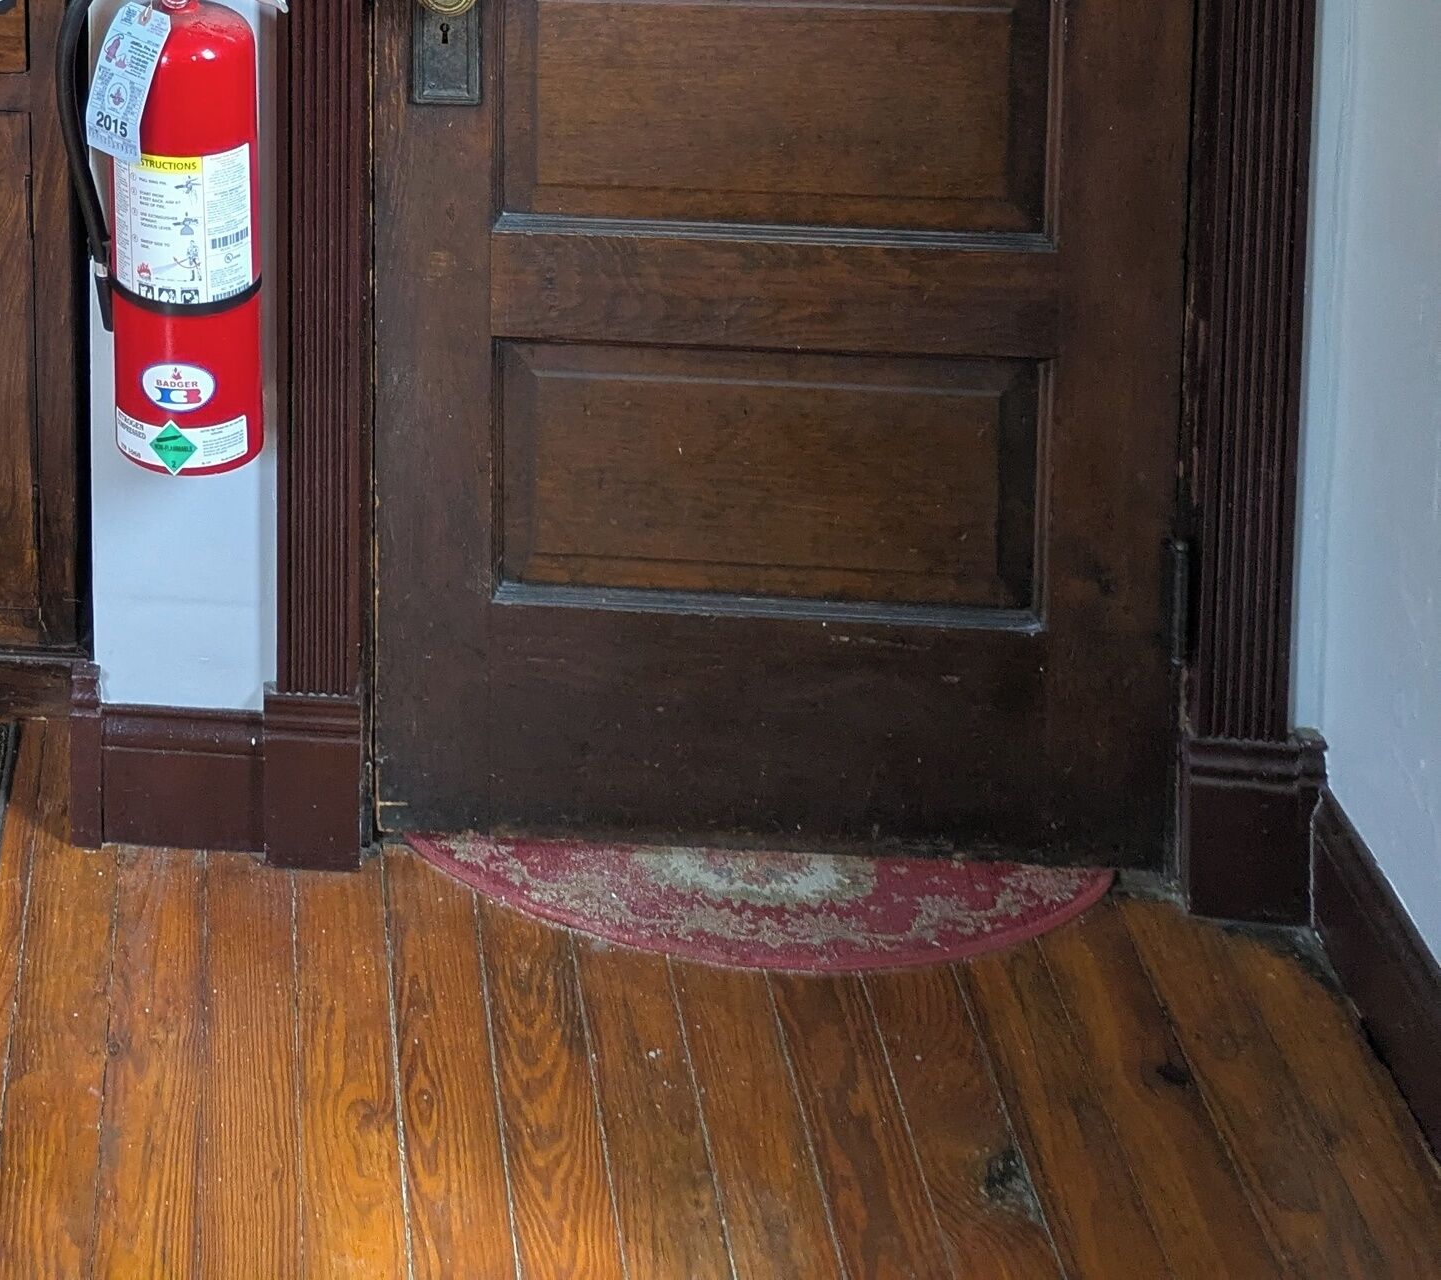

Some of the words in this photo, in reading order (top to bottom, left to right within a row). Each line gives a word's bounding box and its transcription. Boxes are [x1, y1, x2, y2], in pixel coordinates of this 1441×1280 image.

[96, 111, 128, 138] 2015
[141, 159, 197, 170] STRUCTIONS
[156, 379, 198, 388] BADGER
